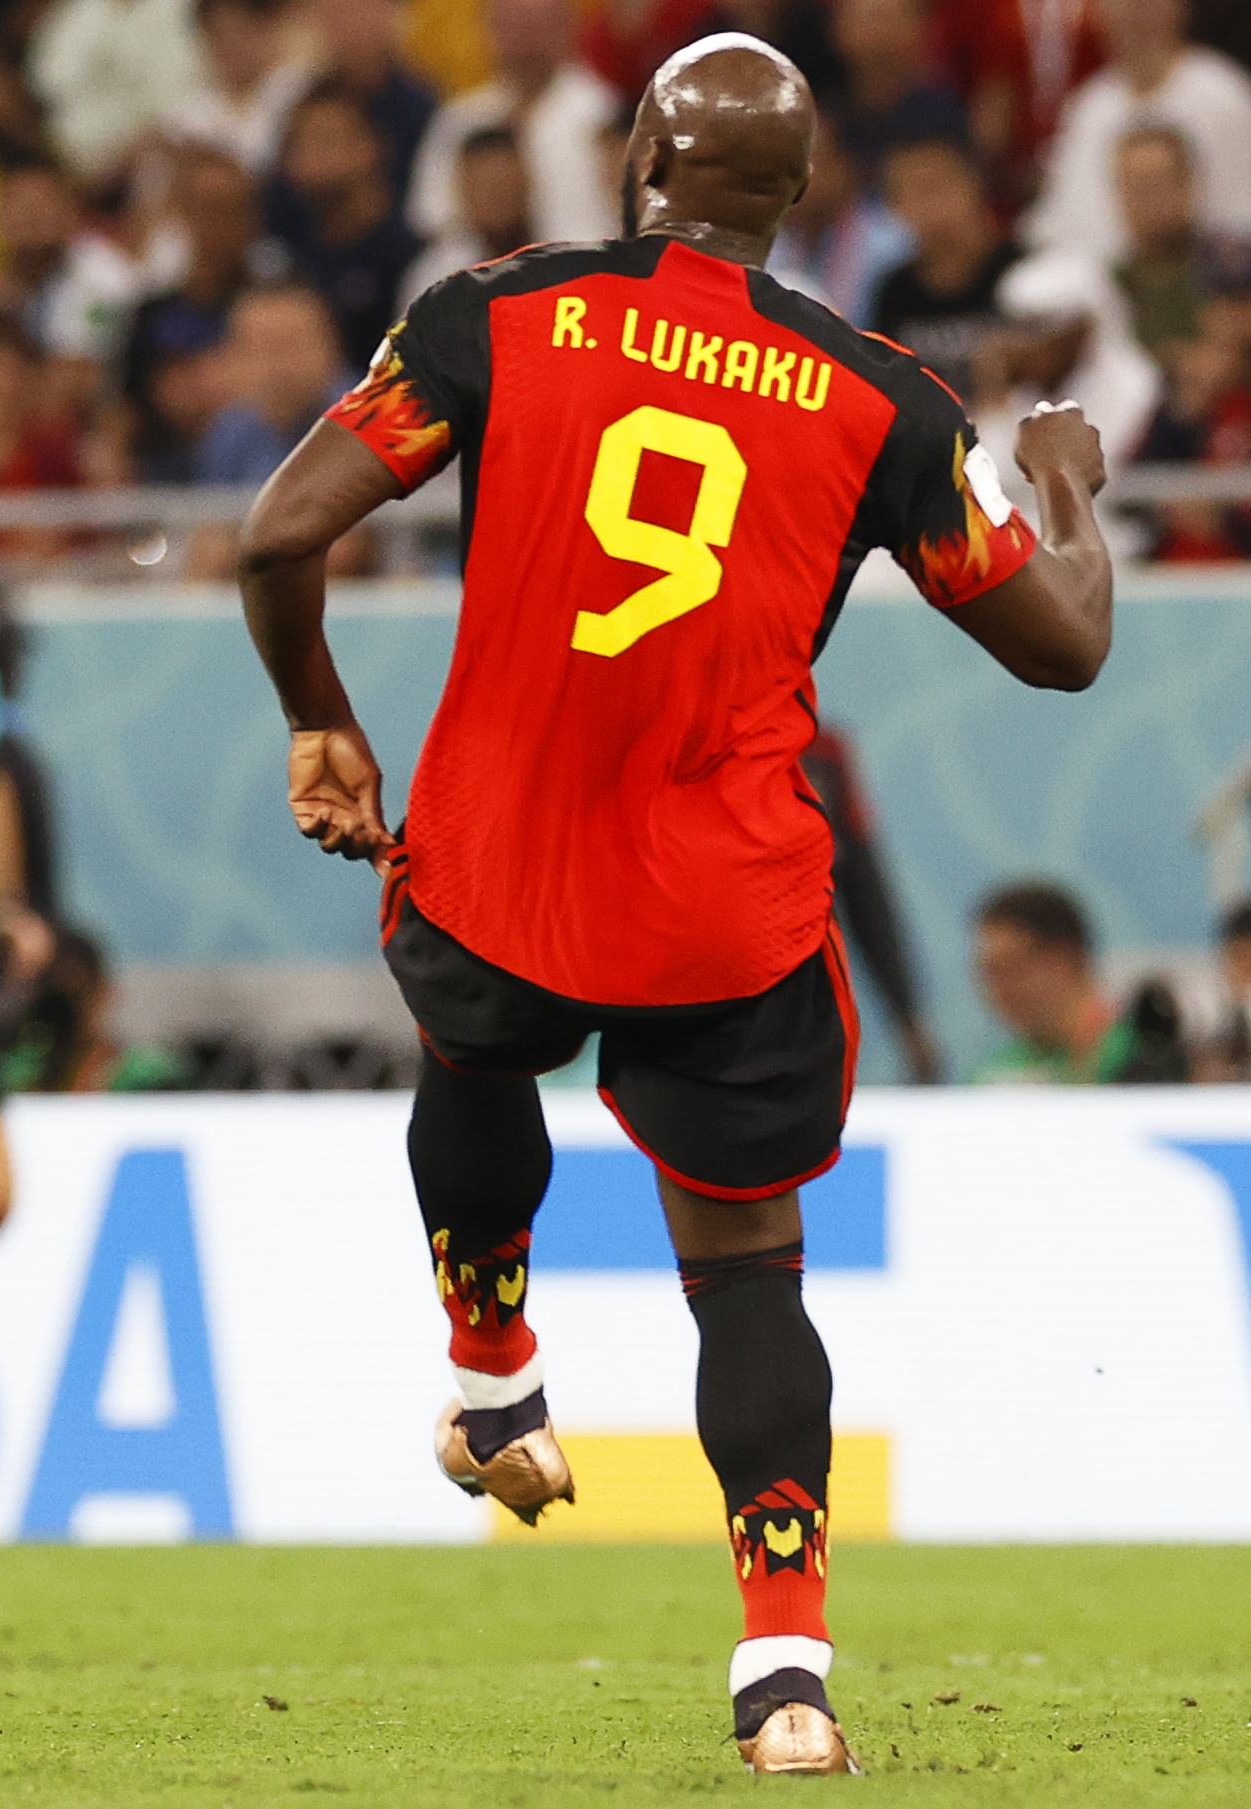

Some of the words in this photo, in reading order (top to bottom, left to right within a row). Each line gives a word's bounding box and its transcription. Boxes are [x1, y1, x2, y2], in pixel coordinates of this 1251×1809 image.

[551, 296, 598, 350] R.
[620, 307, 832, 412] LUKAKU
[570, 405, 748, 659] 9
